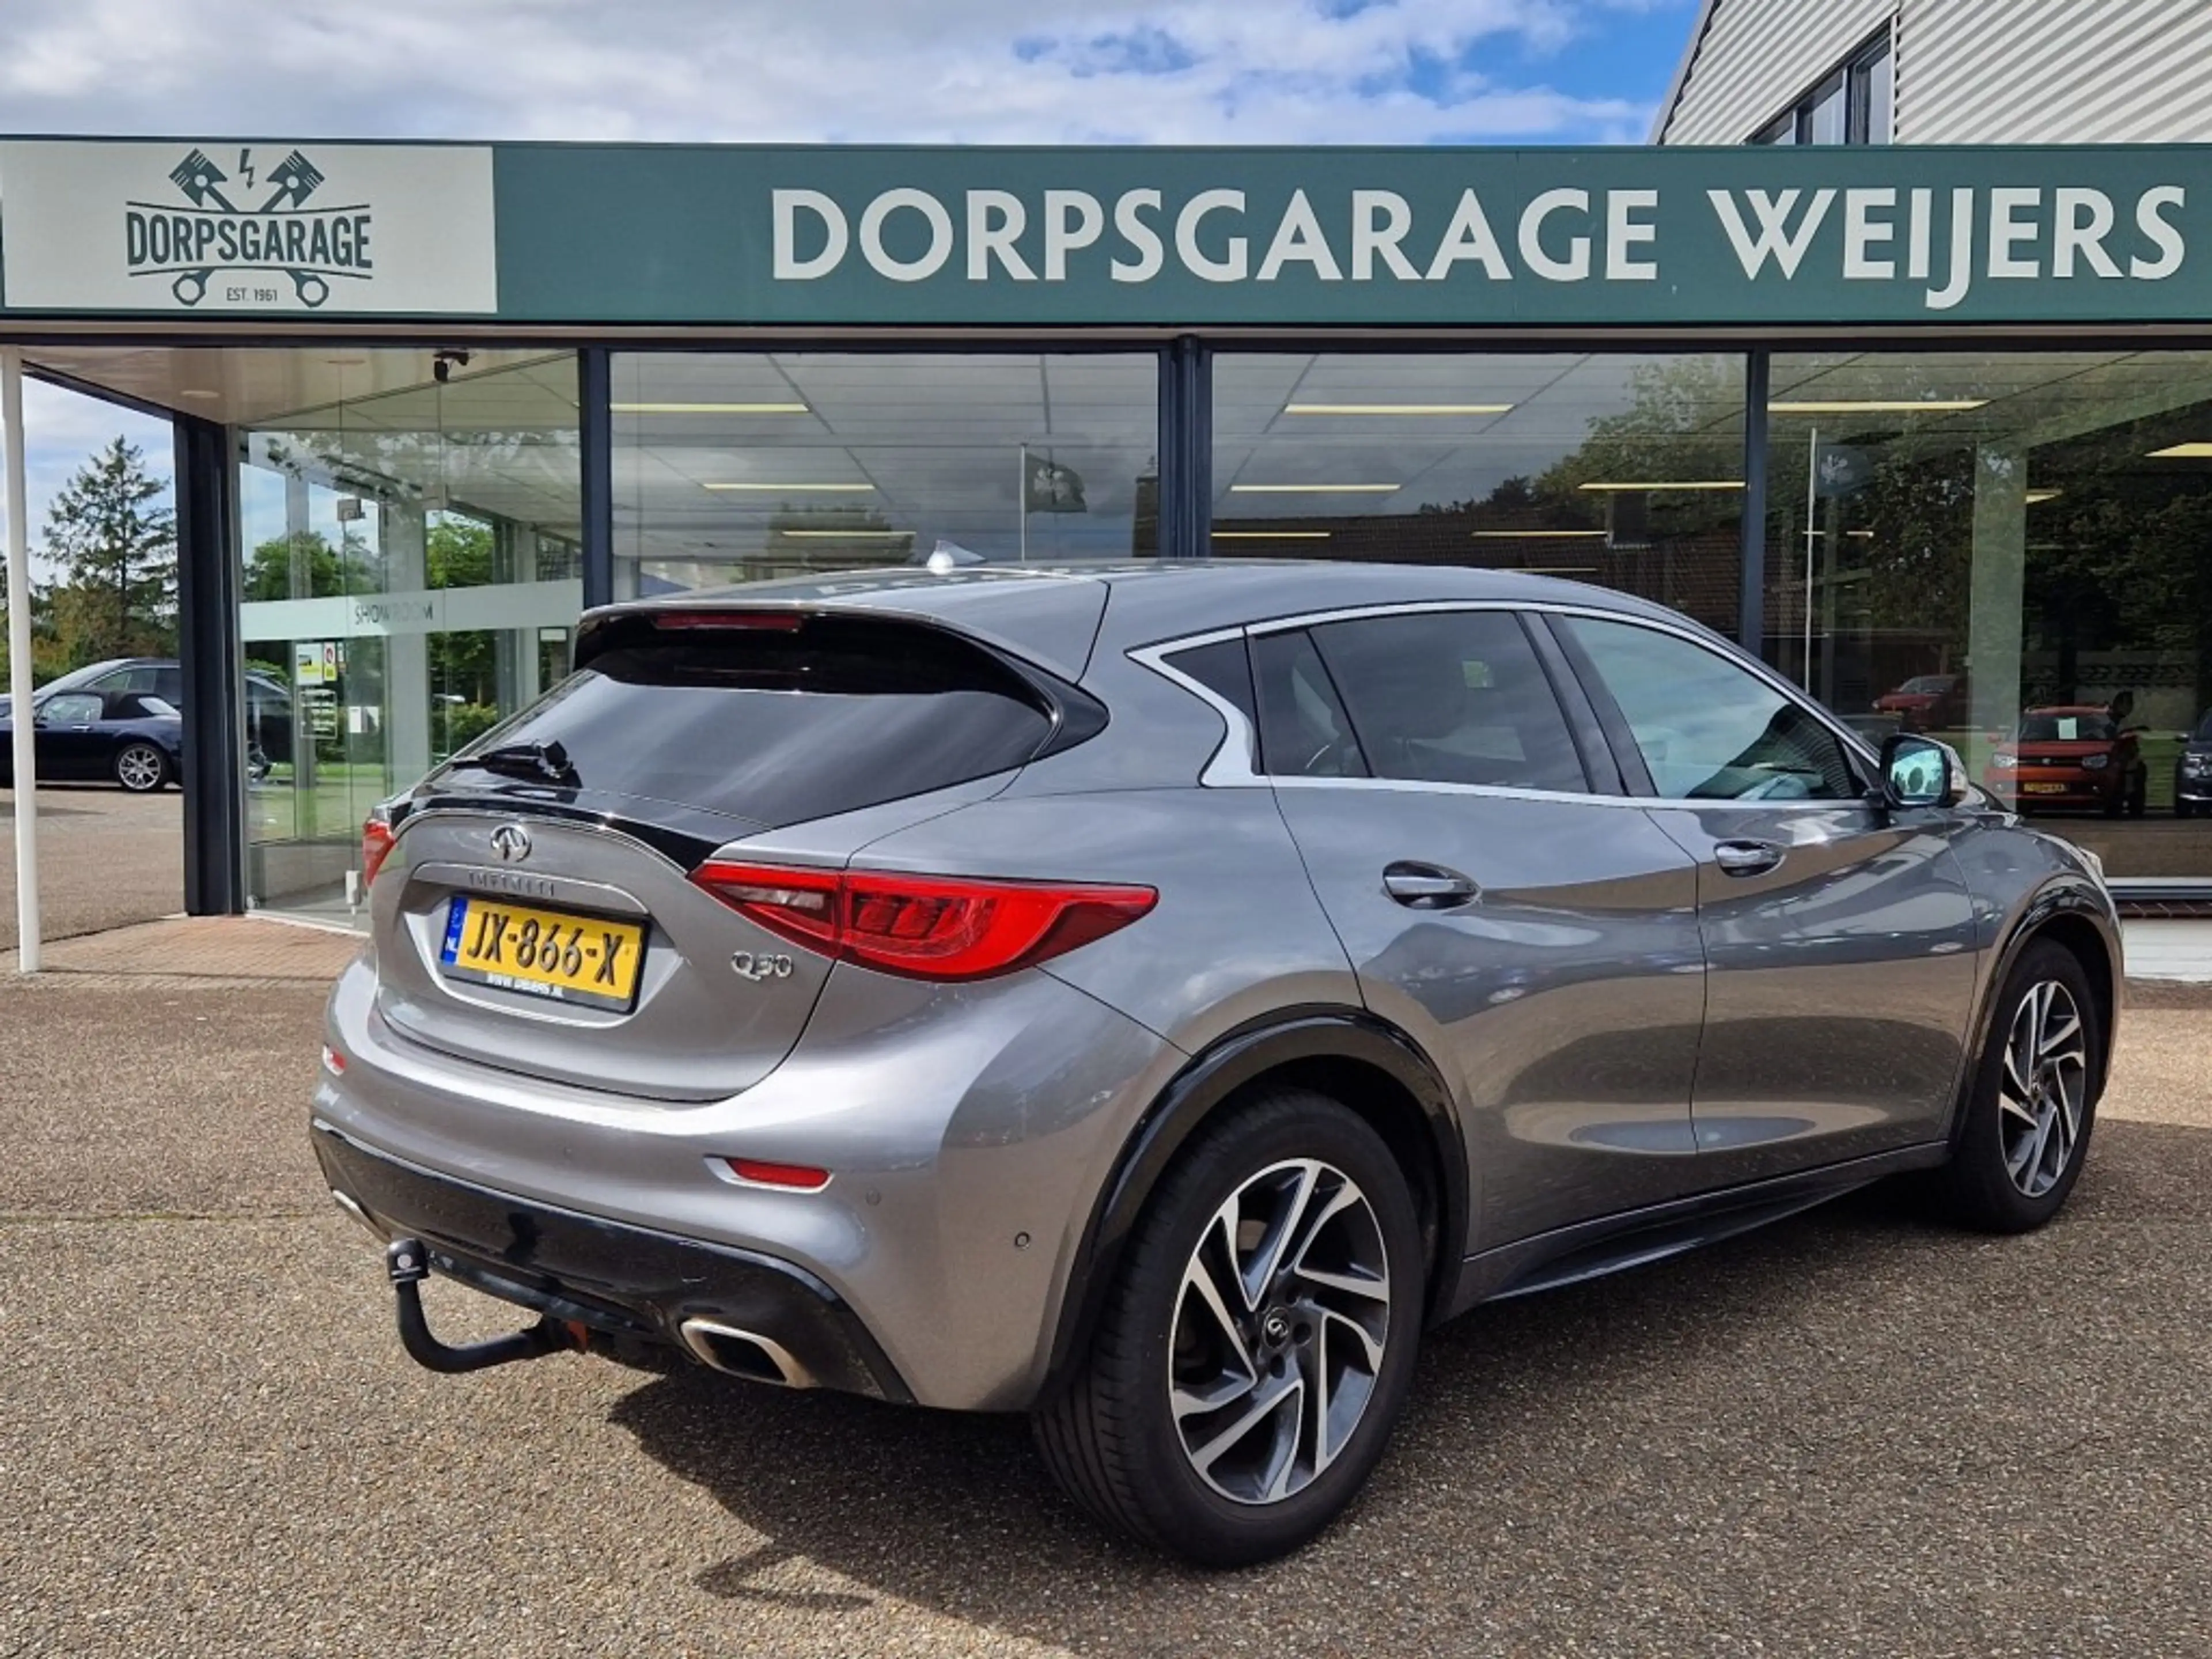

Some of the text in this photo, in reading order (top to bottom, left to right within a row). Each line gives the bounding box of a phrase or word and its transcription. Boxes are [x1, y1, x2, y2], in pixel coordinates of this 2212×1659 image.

[126, 211, 373, 269] DORPSGARAGE
[772, 185, 2186, 309] DORPSGARAGE WEIJERS
[226, 287, 278, 302] EST. 1961
[467, 911, 624, 986] JX-866-X
[730, 950, 793, 982] Q30
